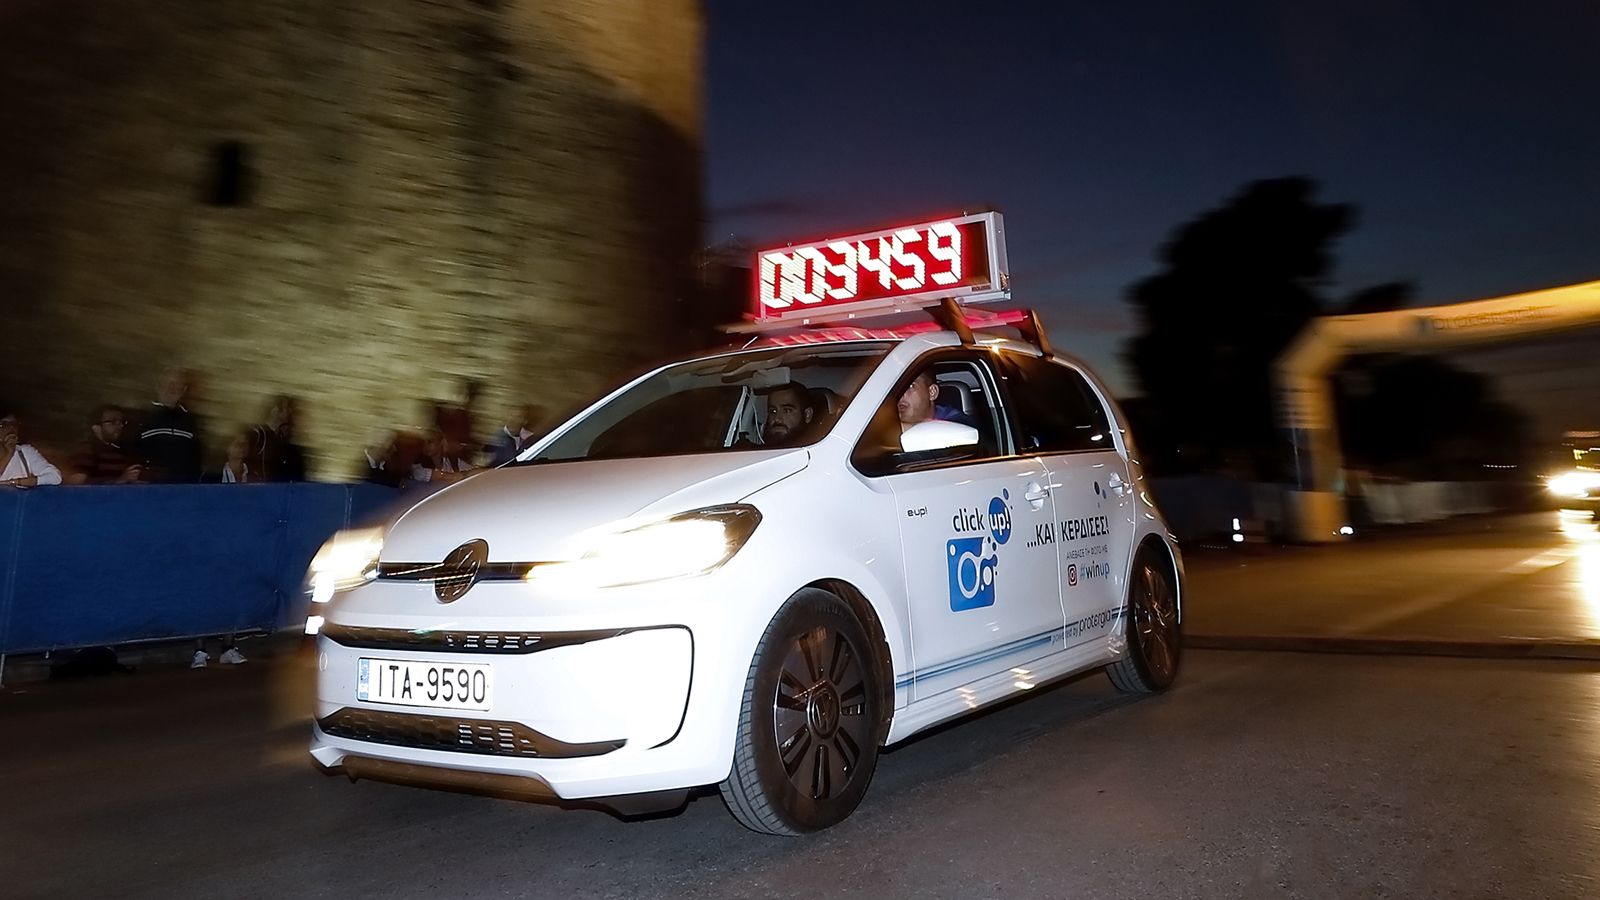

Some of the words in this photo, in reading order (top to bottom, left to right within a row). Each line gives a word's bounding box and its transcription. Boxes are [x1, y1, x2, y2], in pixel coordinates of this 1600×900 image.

[760, 221, 962, 309] 003459
[953, 508, 985, 532] click
[989, 507, 1010, 536] up!
[1061, 515, 1110, 542] ΚΕΡΔΙΣΕΣ!
[1080, 560, 1110, 580] #winup
[379, 664, 485, 703] ITA-9590
